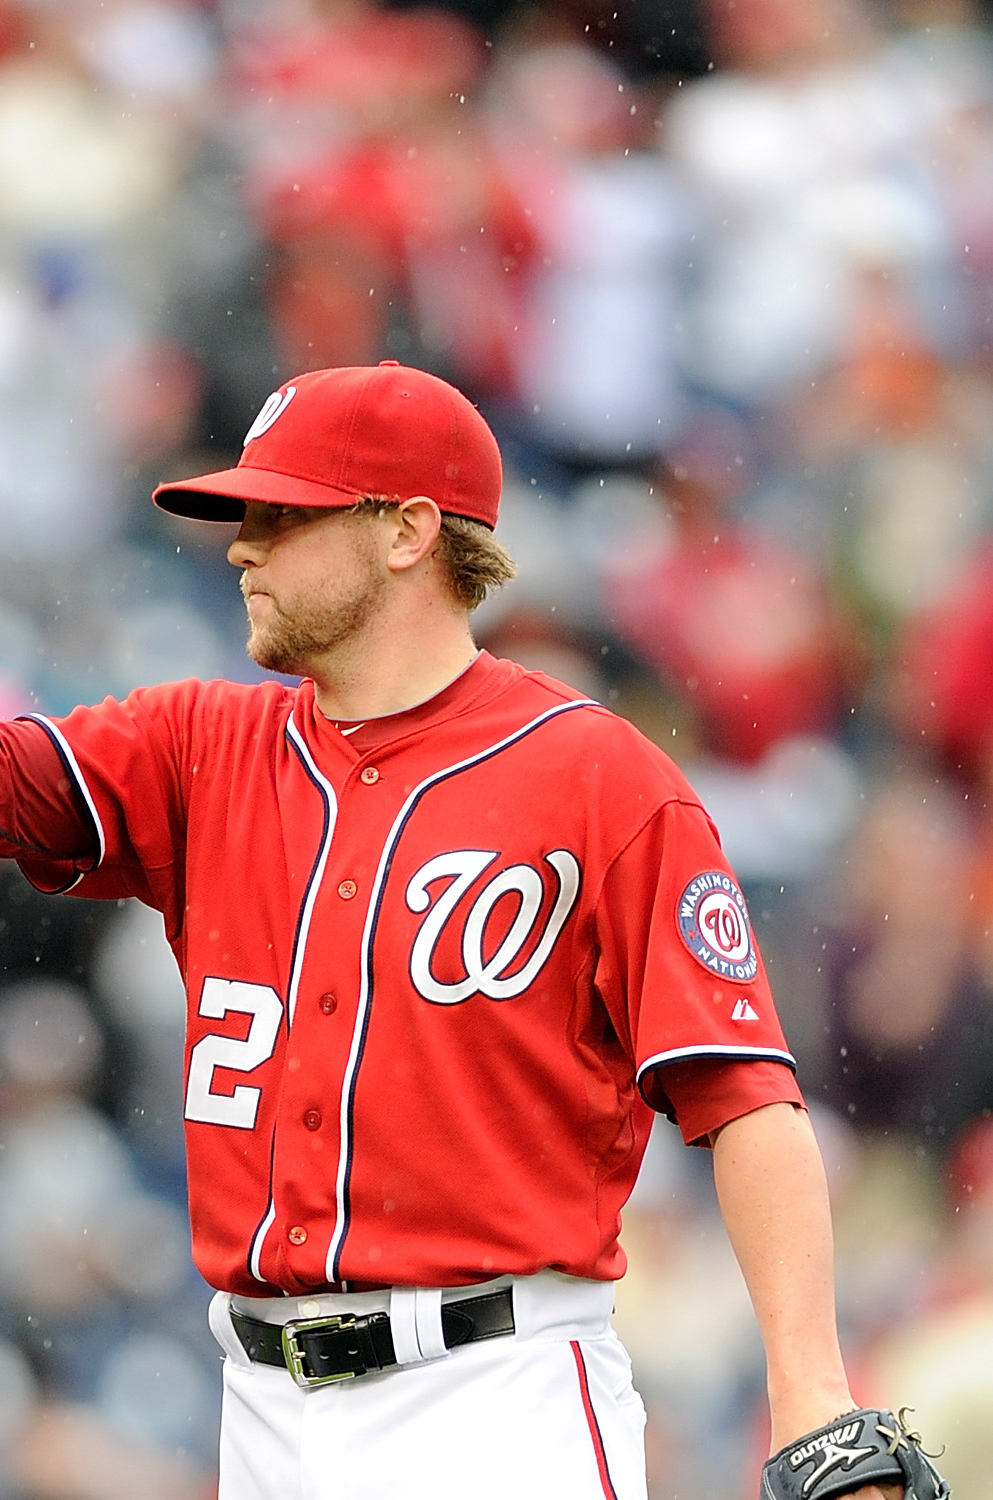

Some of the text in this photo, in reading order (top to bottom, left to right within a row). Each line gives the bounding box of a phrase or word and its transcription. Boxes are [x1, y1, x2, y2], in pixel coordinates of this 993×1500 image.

[406, 850, 582, 1004] W
[705, 902, 741, 952] W
[184, 976, 285, 1130] 2
[790, 1422, 860, 1466] MIZUNO
